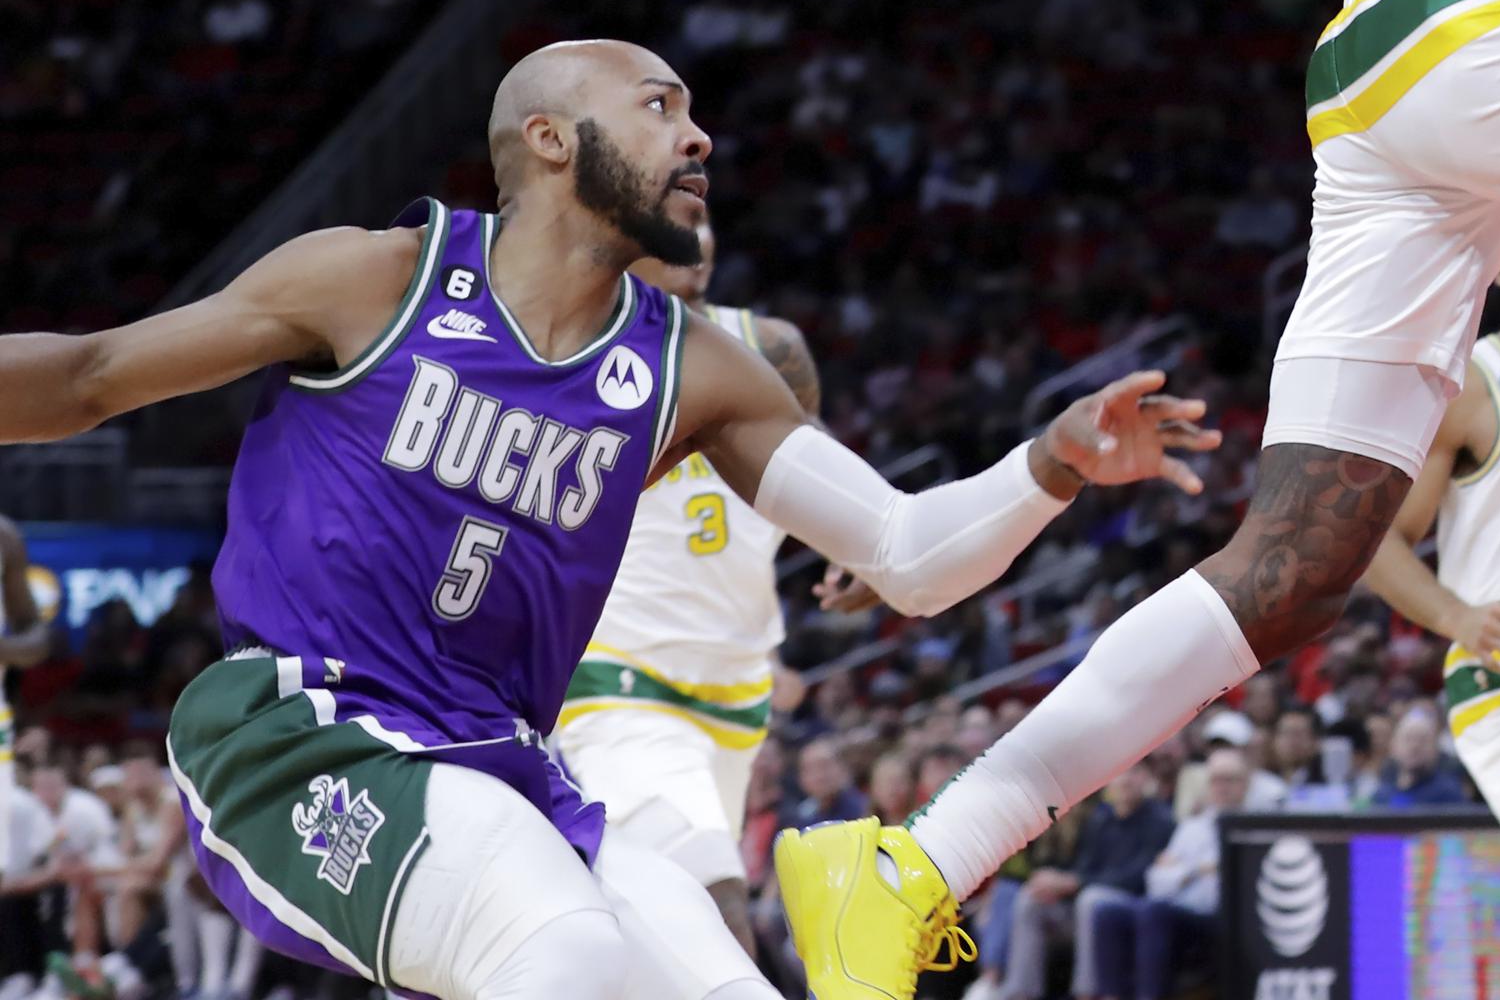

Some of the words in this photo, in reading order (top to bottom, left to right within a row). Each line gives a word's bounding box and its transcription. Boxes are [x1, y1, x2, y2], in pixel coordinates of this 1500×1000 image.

[440, 308, 488, 335] NIKE
[445, 267, 476, 300] 6
[382, 354, 631, 532] BUCKS
[683, 491, 730, 558] 3
[431, 514, 510, 623] 5
[324, 802, 377, 887] BUCKS
